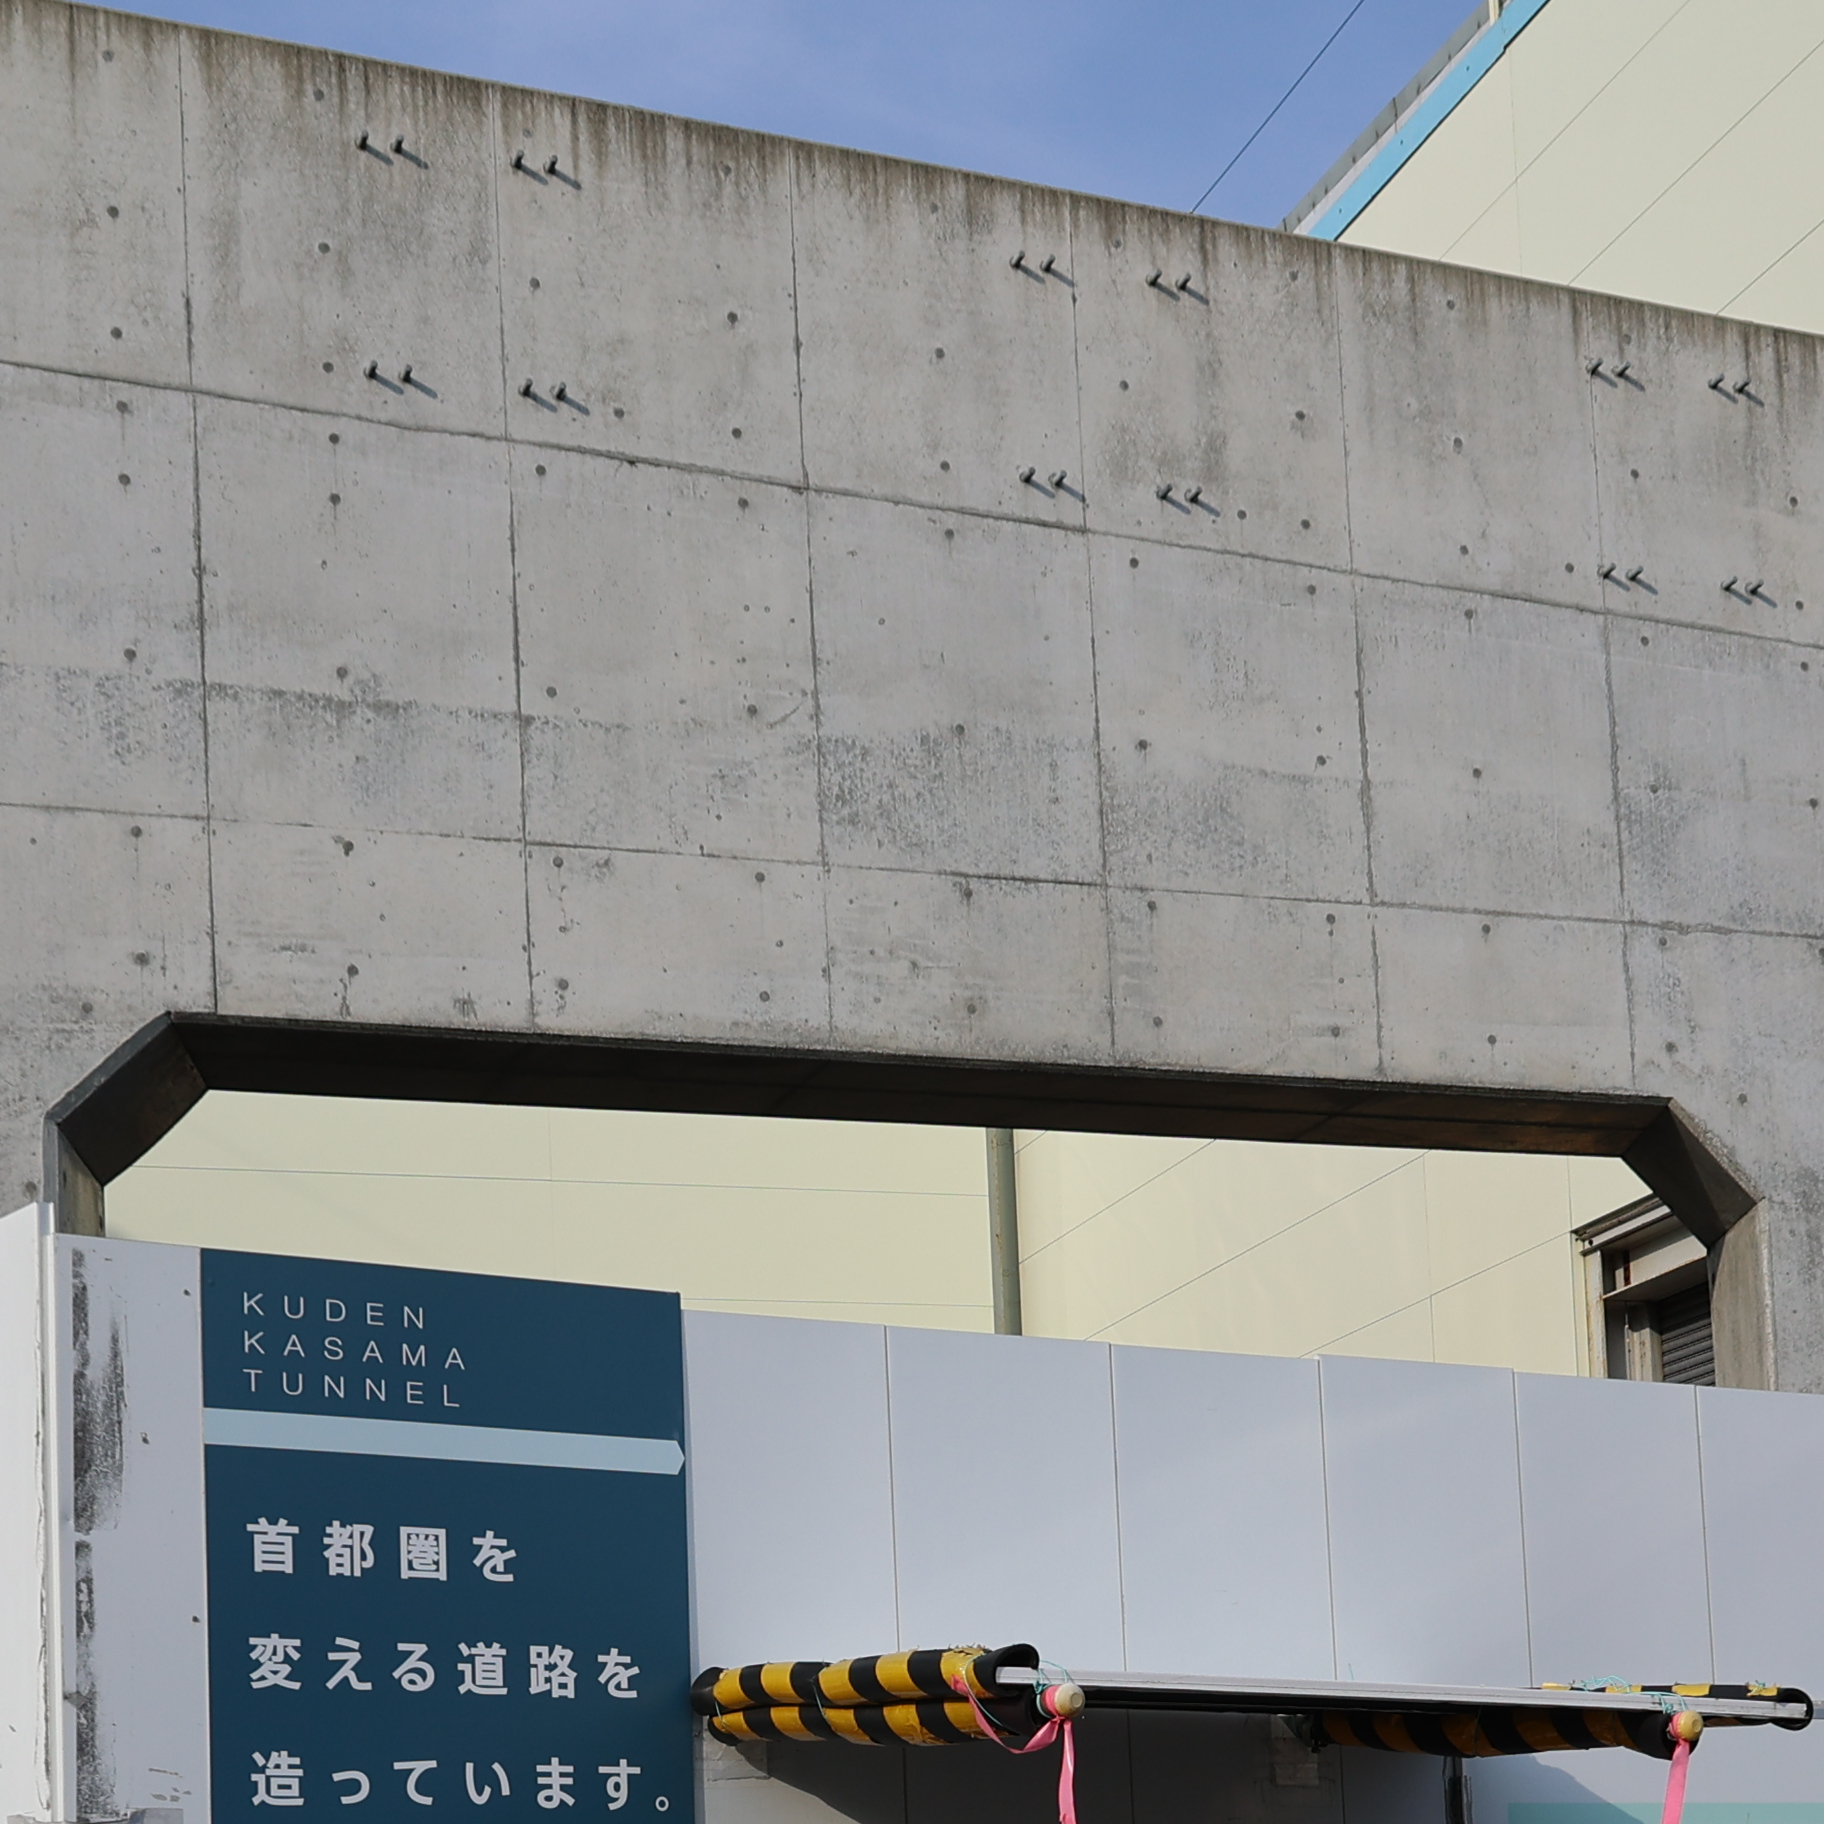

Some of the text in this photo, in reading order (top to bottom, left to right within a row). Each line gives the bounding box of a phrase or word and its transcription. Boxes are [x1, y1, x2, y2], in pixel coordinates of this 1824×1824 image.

[242, 1292, 425, 1330] KUDEN
[242, 1331, 466, 1371] KASAMA
[242, 1369, 461, 1407] TUNNEL
[246, 1517, 517, 1582] 首都圏を
[248, 1633, 641, 1699] 変える道路を
[250, 1750, 669, 1812] 造っています。
